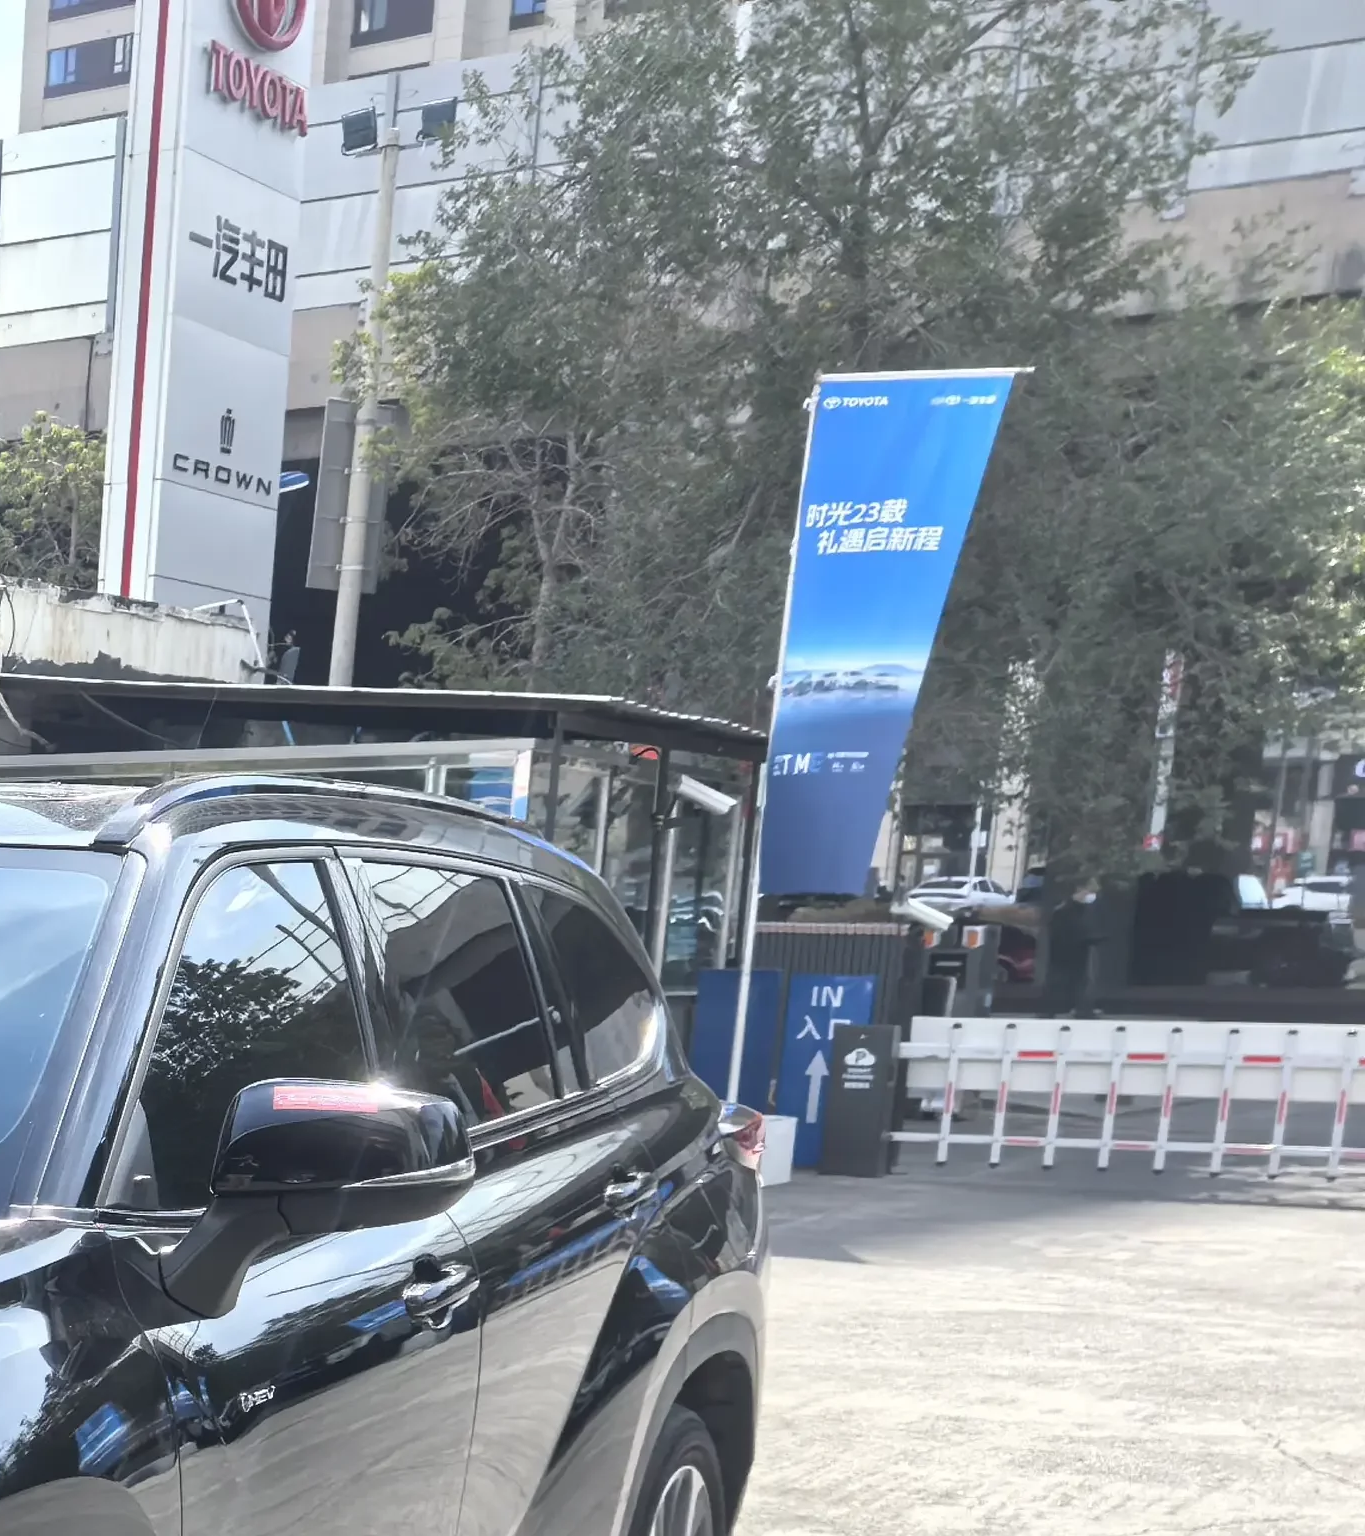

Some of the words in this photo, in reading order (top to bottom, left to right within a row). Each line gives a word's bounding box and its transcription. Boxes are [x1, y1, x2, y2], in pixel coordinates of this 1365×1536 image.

[210, 39, 308, 137] TOYOTA
[189, 215, 289, 303] 一汽丰田
[842, 395, 889, 408] TOYOTA
[173, 452, 272, 498] CROWN
[805, 498, 908, 528] 时光23载
[816, 525, 943, 555] 礼遇启新程
[810, 985, 844, 1007] IN
